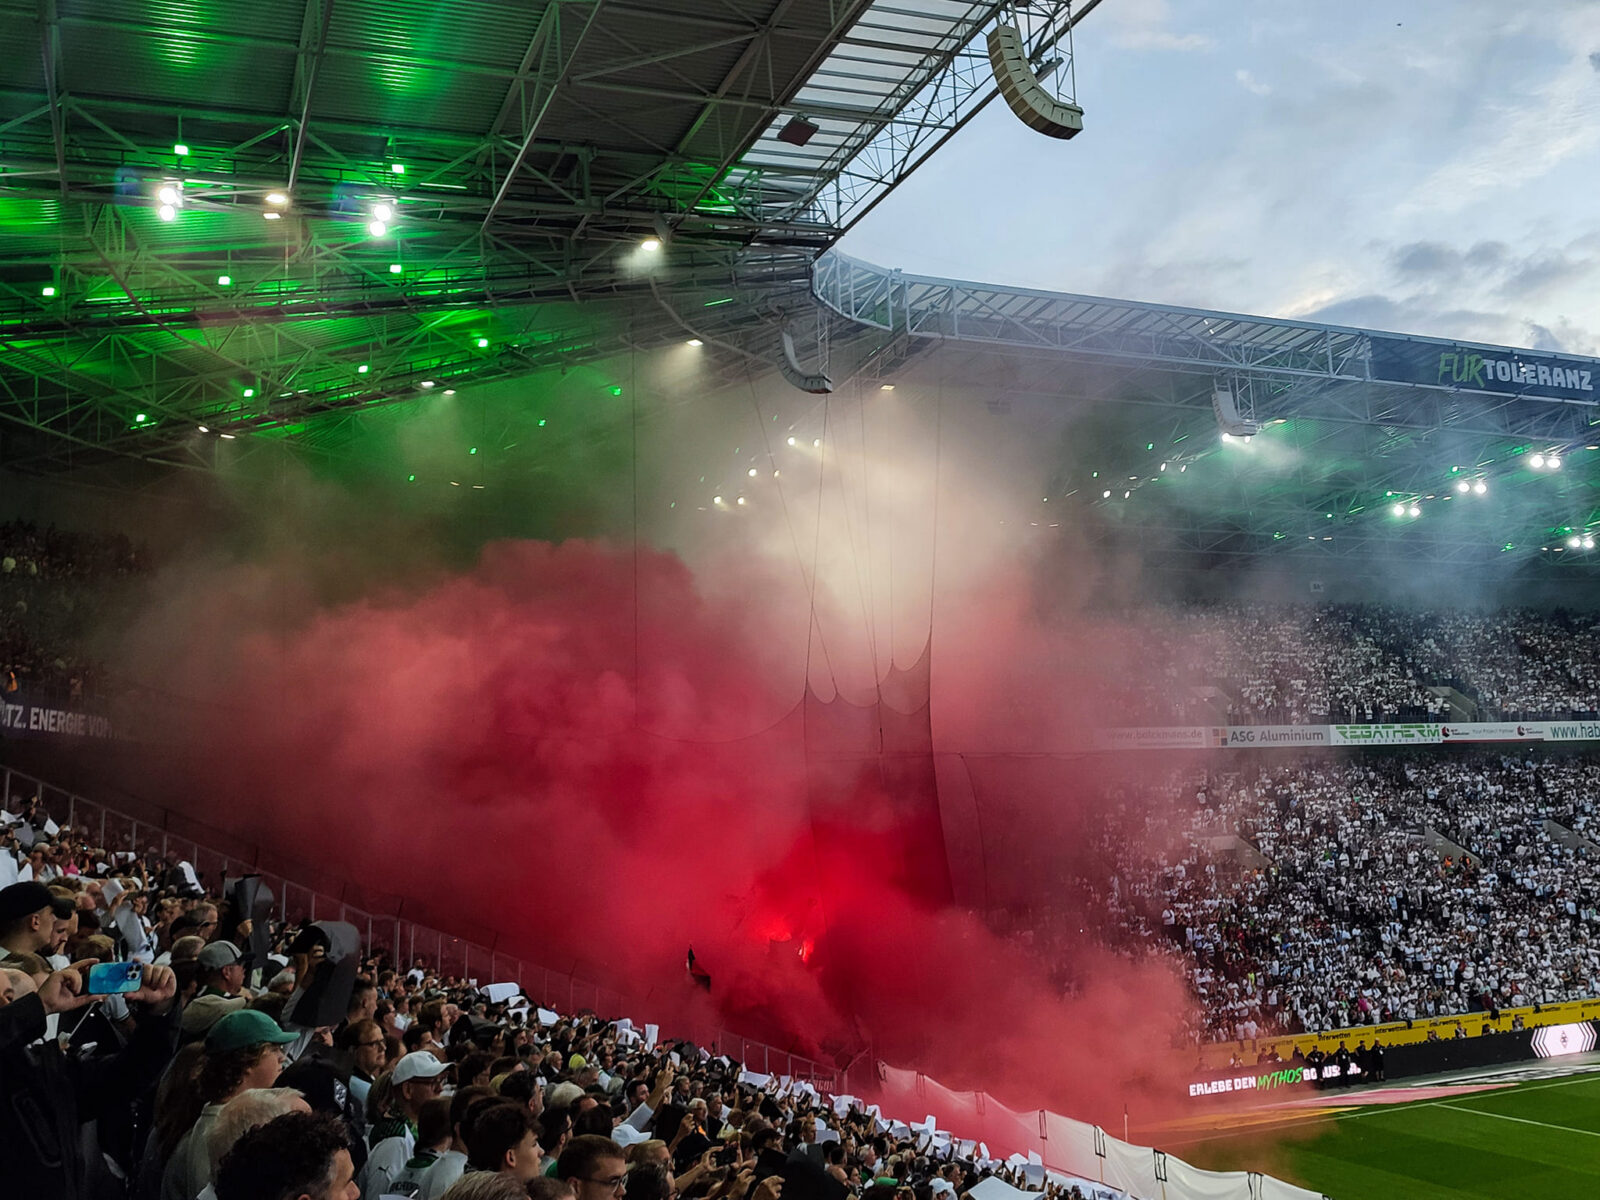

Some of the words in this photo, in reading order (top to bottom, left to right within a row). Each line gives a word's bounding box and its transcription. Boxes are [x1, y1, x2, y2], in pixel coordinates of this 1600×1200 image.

[1483, 359, 1594, 391] TOLERANZ
[30, 707, 86, 736] ENERGIE
[1231, 730, 1255, 742] ASG
[1260, 729, 1324, 742] Aluminium
[1336, 724, 1440, 739] REGATHERM
[1189, 1078, 1233, 1096] ERLEBE
[1234, 1076, 1256, 1089] DEN
[1256, 1066, 1304, 1091] MYTHOS
